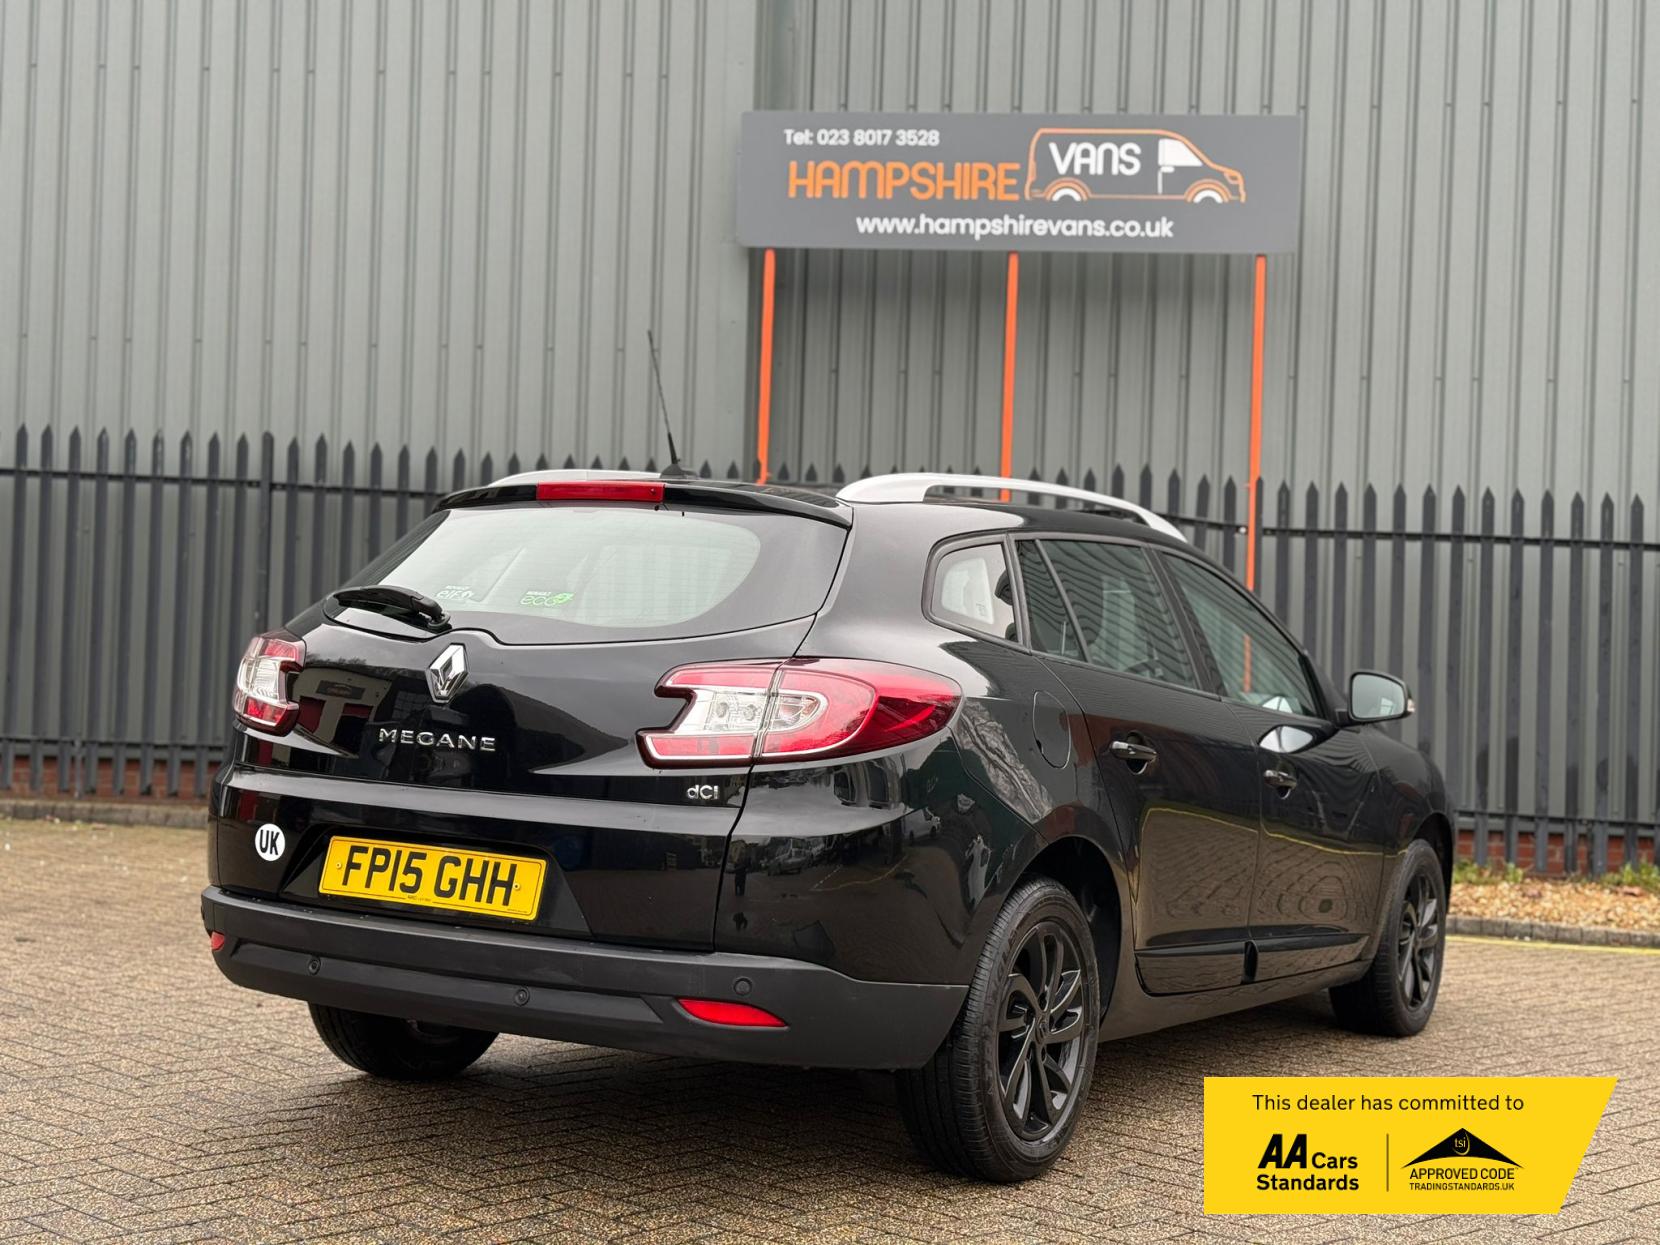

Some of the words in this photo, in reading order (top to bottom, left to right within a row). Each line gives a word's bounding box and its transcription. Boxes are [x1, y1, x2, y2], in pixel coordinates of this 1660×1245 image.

[784, 128, 814, 146] Tel:
[817, 128, 849, 146] 023
[853, 129, 892, 146] 8017
[895, 129, 940, 147] 3528
[788, 160, 1021, 201] HAMPSHIRE
[1048, 141, 1142, 176] VANS
[856, 213, 1175, 241] www.hampshirevans.co.uk
[378, 728, 496, 752] MEGANE
[258, 829, 280, 856] UK
[341, 844, 428, 894] FP15
[433, 855, 518, 907] GHH
